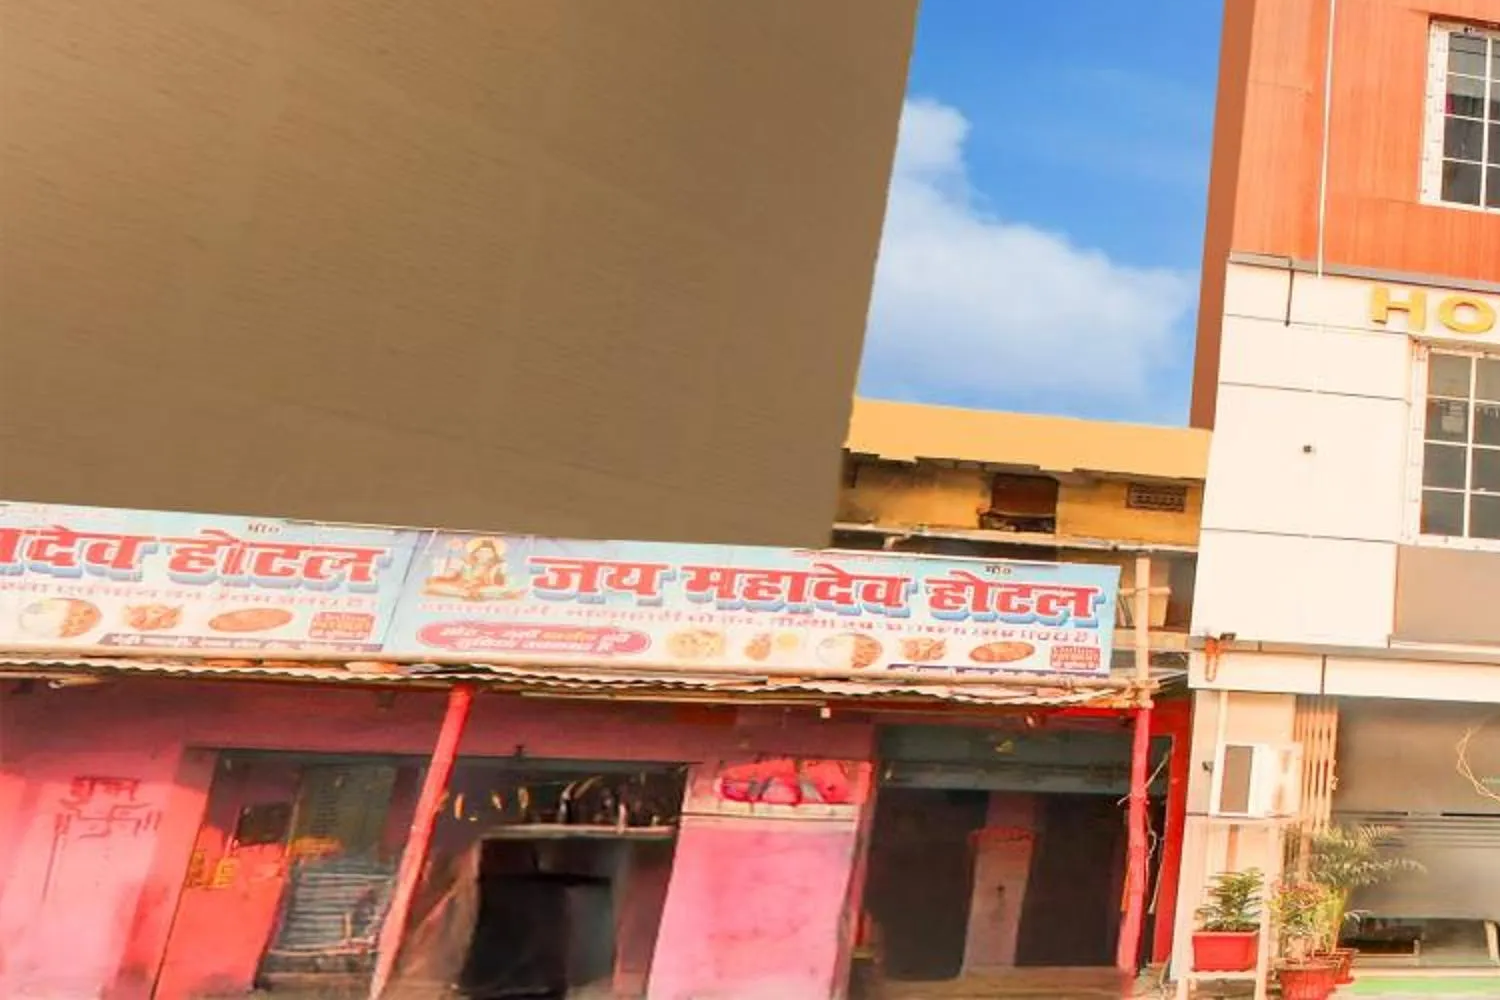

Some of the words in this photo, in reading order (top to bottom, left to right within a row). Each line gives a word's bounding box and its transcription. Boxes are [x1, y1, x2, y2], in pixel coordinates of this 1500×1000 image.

[160, 529, 386, 586] होटल
[528, 556, 670, 599] जय
[681, 562, 912, 611] महादेव
[925, 569, 1099, 620] होटल
